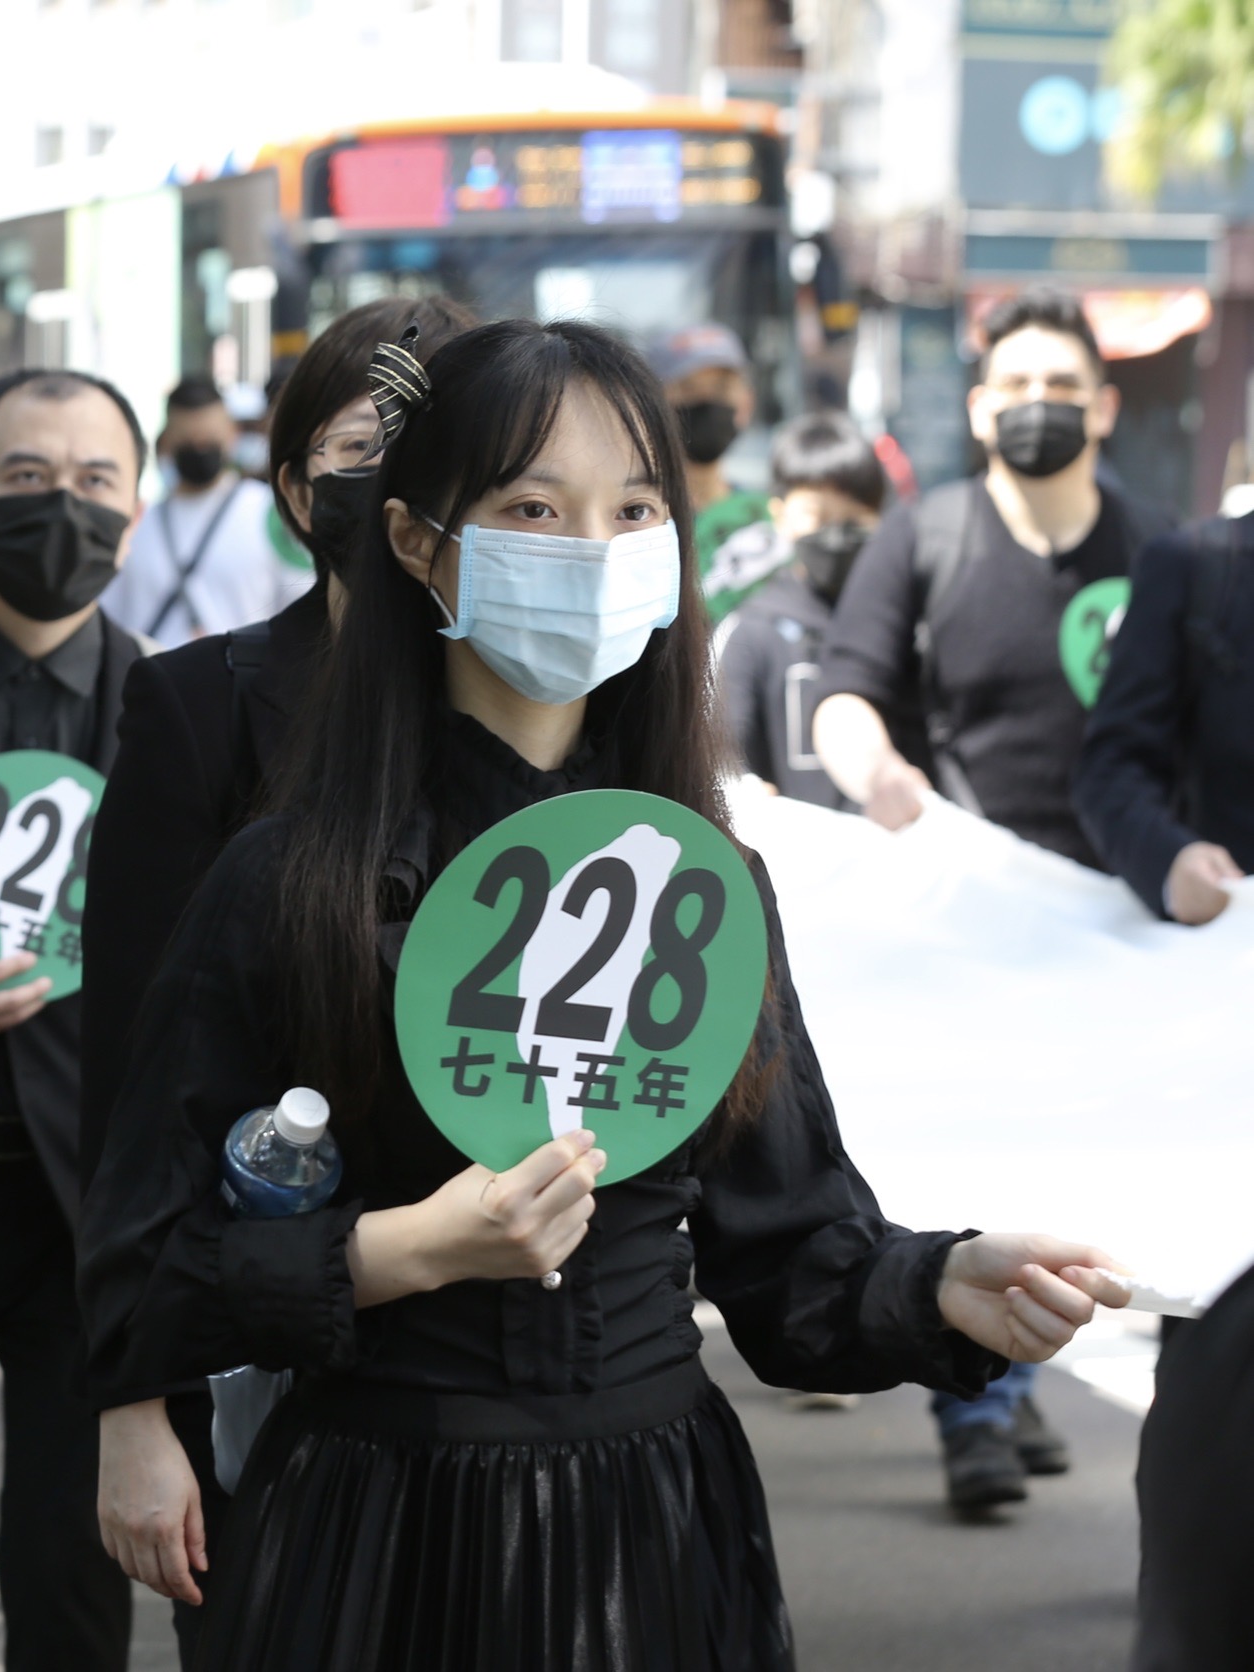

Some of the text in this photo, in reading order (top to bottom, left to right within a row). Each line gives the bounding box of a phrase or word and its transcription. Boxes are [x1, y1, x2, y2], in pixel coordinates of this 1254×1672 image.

[446, 845, 726, 1051] 228
[440, 1036, 689, 1118] 七十五年
